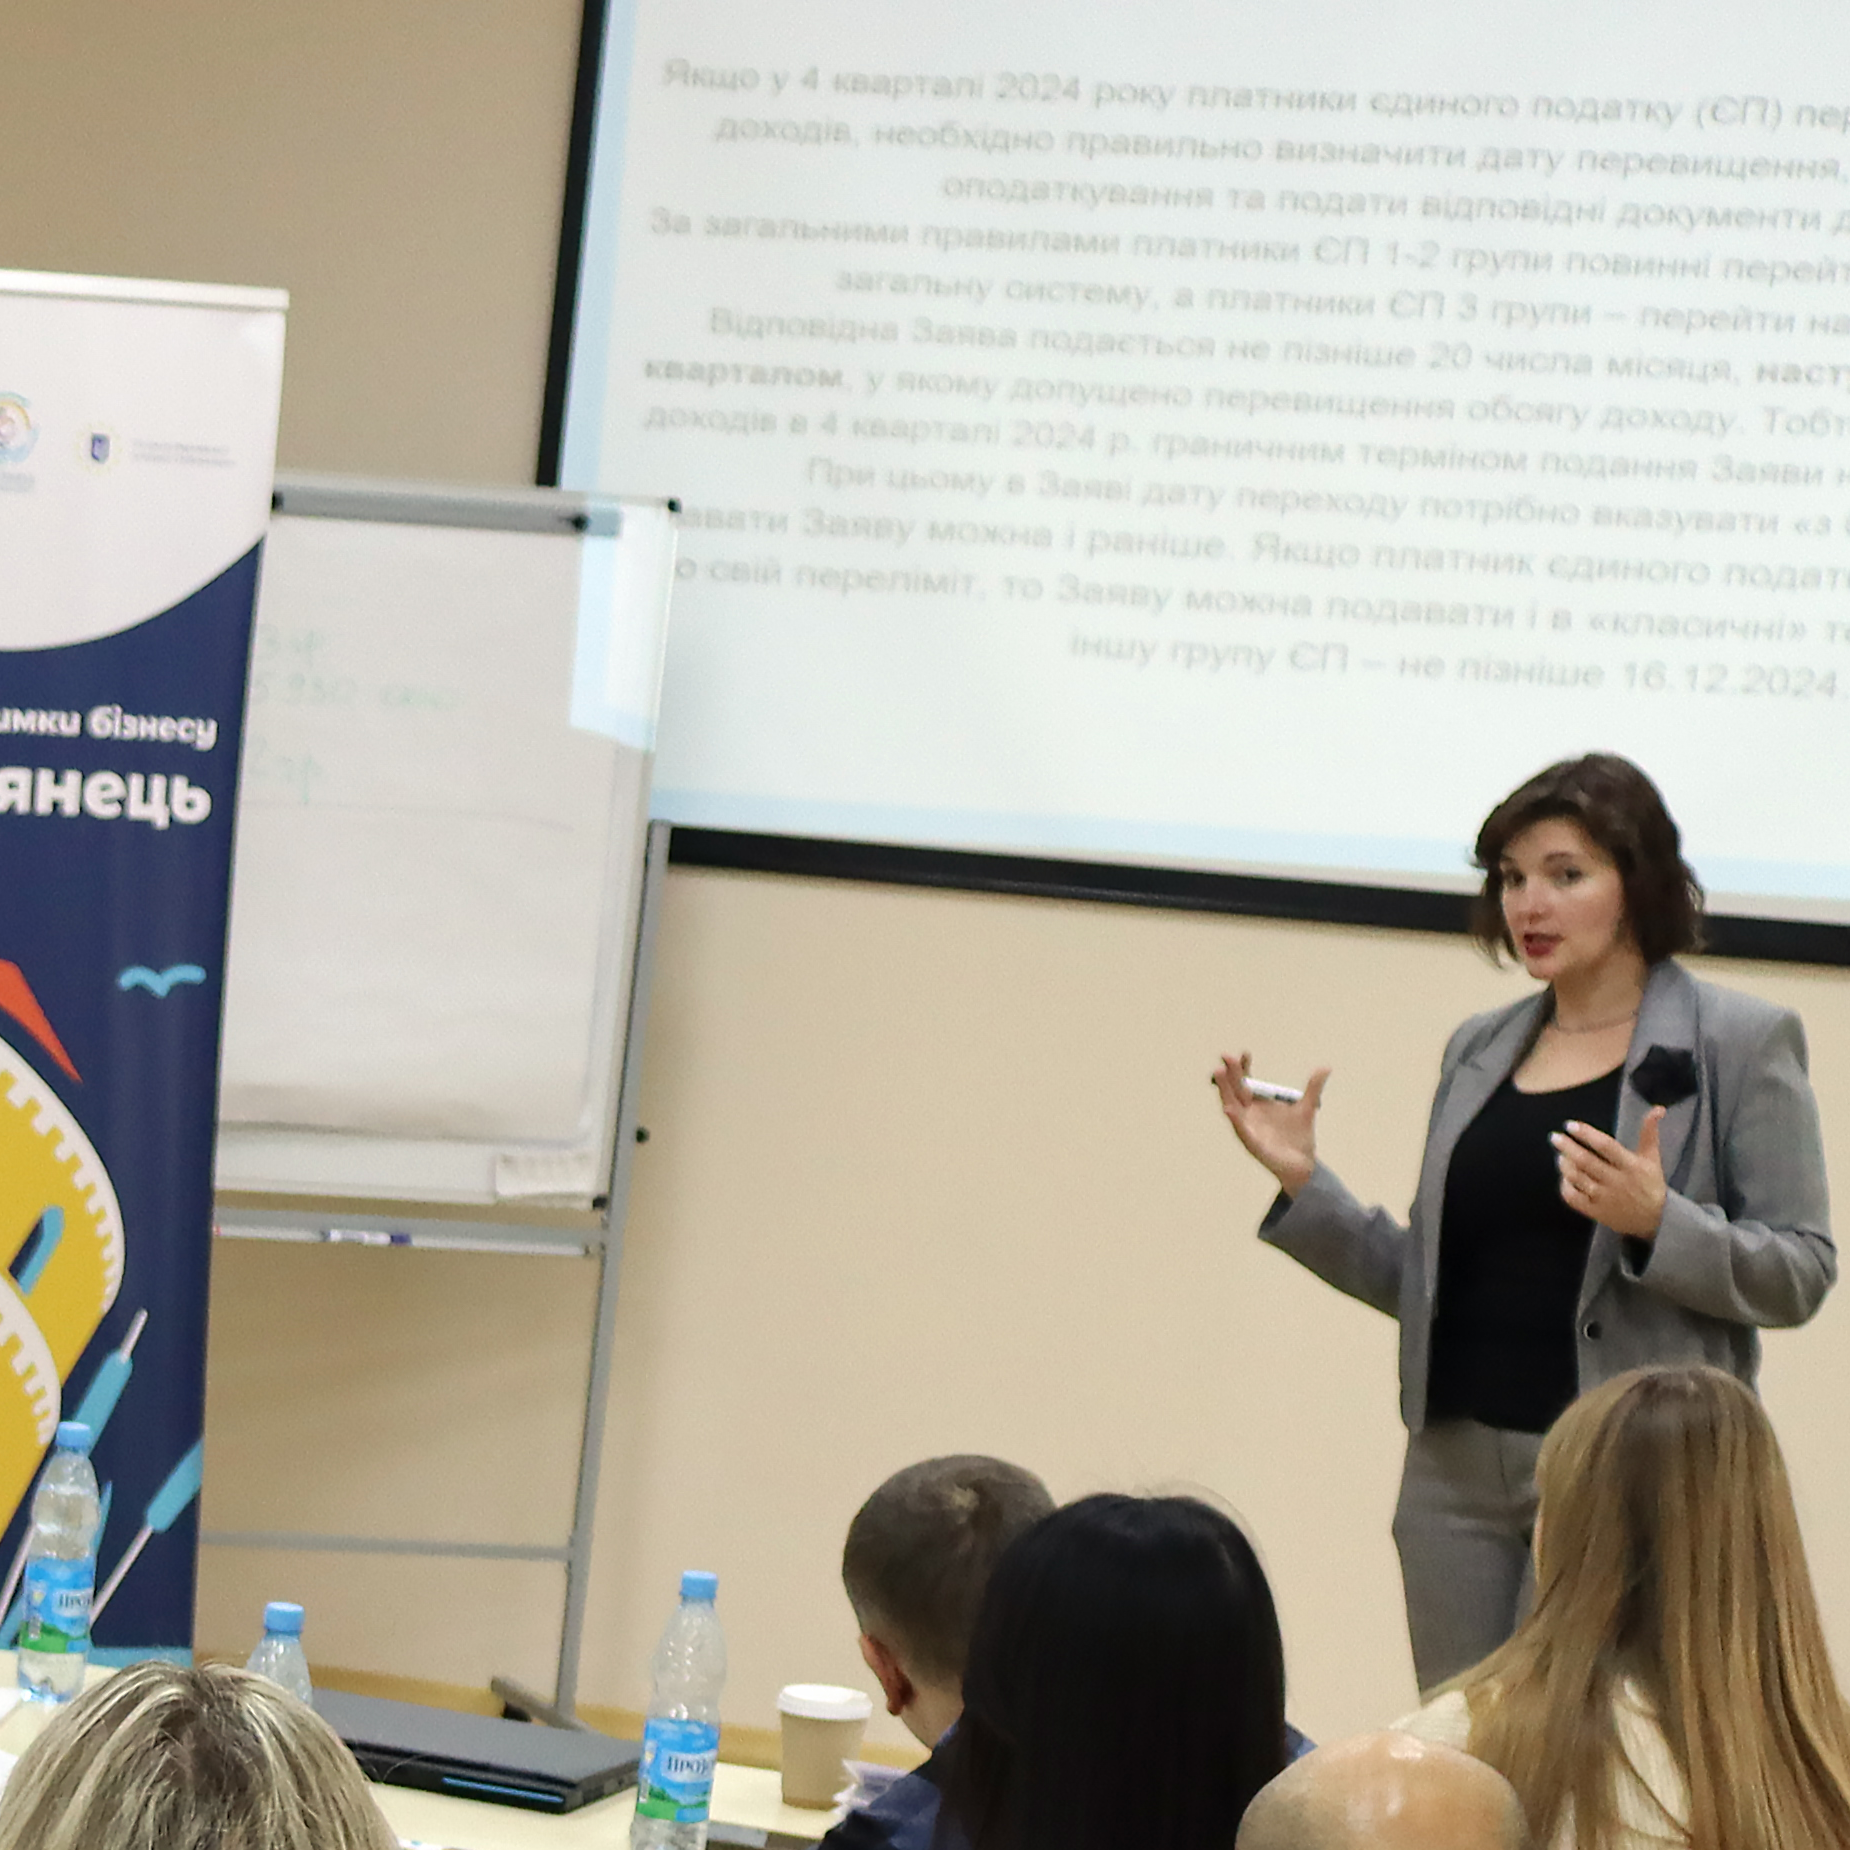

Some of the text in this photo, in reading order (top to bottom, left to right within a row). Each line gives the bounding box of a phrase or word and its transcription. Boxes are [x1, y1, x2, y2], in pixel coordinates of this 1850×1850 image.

[660, 58, 762, 92] Якщо
[767, 72, 791, 96] у
[797, 66, 821, 91] 4
[828, 74, 985, 99] кварталі
[992, 73, 1082, 102] 2024
[1089, 83, 1177, 109] року
[1183, 86, 1358, 111] платники
[1365, 93, 1521, 117] єдиного
[1527, 97, 1685, 126] податку
[1692, 96, 1784, 131] (ЄП)
[871, 122, 1055, 153] необхідно
[1065, 133, 1263, 159] правильно
[1273, 142, 1467, 166] визначити
[1475, 147, 1565, 175] дату
[940, 179, 1214, 206] оподаткування
[1227, 189, 1266, 211] та
[1276, 191, 1408, 216] подати
[1419, 196, 1606, 224] відповідні
[1615, 204, 1822, 230] документи
[651, 207, 691, 236] За
[704, 217, 909, 243] загальними
[921, 227, 1120, 253] правилами
[1133, 236, 1300, 261] платники
[1313, 236, 1370, 264] ЄП
[1387, 241, 1440, 269] 1-2
[1452, 249, 1553, 274] групи
[1565, 253, 1710, 277] повинні
[835, 272, 993, 299] загальну
[1172, 288, 1194, 309] а
[1205, 290, 1376, 315] платники
[1387, 290, 1445, 319] ЄП
[1457, 293, 1478, 321] 3
[1490, 301, 1592, 327] групи
[1638, 307, 1796, 332] перейти
[708, 309, 899, 342] Відповідна
[911, 318, 1017, 348] Заява
[1028, 331, 1216, 356] подається
[1226, 341, 1271, 361] не
[1282, 342, 1416, 367] пізніше
[1427, 342, 1473, 370] 20
[1483, 352, 1593, 374] числа
[865, 371, 886, 398] у
[897, 372, 999, 401] якому
[1011, 380, 1191, 406] допущено
[1206, 390, 1454, 418] перевищення
[1468, 395, 1586, 429] обсягу
[642, 408, 777, 434] доходів
[788, 414, 808, 435] в
[819, 411, 838, 435] 4
[851, 419, 1000, 443] кварталі
[1012, 421, 1095, 449] 2024
[1152, 435, 1345, 462] граничним
[1359, 446, 1528, 471] терміном
[1540, 454, 1698, 479] подання
[1711, 456, 1824, 485] Заяви
[803, 457, 1832, 535] При цьому в Заяві дату переходу потрібно вказувати «з
[800, 509, 917, 543] Заяву
[924, 522, 1054, 547] можна
[1064, 525, 1074, 549] і
[1248, 533, 1361, 567] Якщо
[1369, 547, 1536, 573] платник
[1544, 557, 1712, 583] єдиного
[708, 552, 782, 584] свій
[1004, 577, 1044, 602] то
[1057, 573, 1173, 614] Заяву
[1186, 591, 1311, 618] можна
[1330, 599, 1514, 628] подавати
[1528, 600, 1538, 630] і
[1552, 608, 1573, 632] в
[1588, 611, 1807, 646] «класичні»
[1068, 633, 1157, 668] іншу
[1169, 640, 1276, 674] групу
[1287, 640, 1350, 673] ЄП
[1399, 655, 1447, 681] не
[1457, 656, 1605, 689] пізніше
[88, 704, 219, 751] бізнесу
